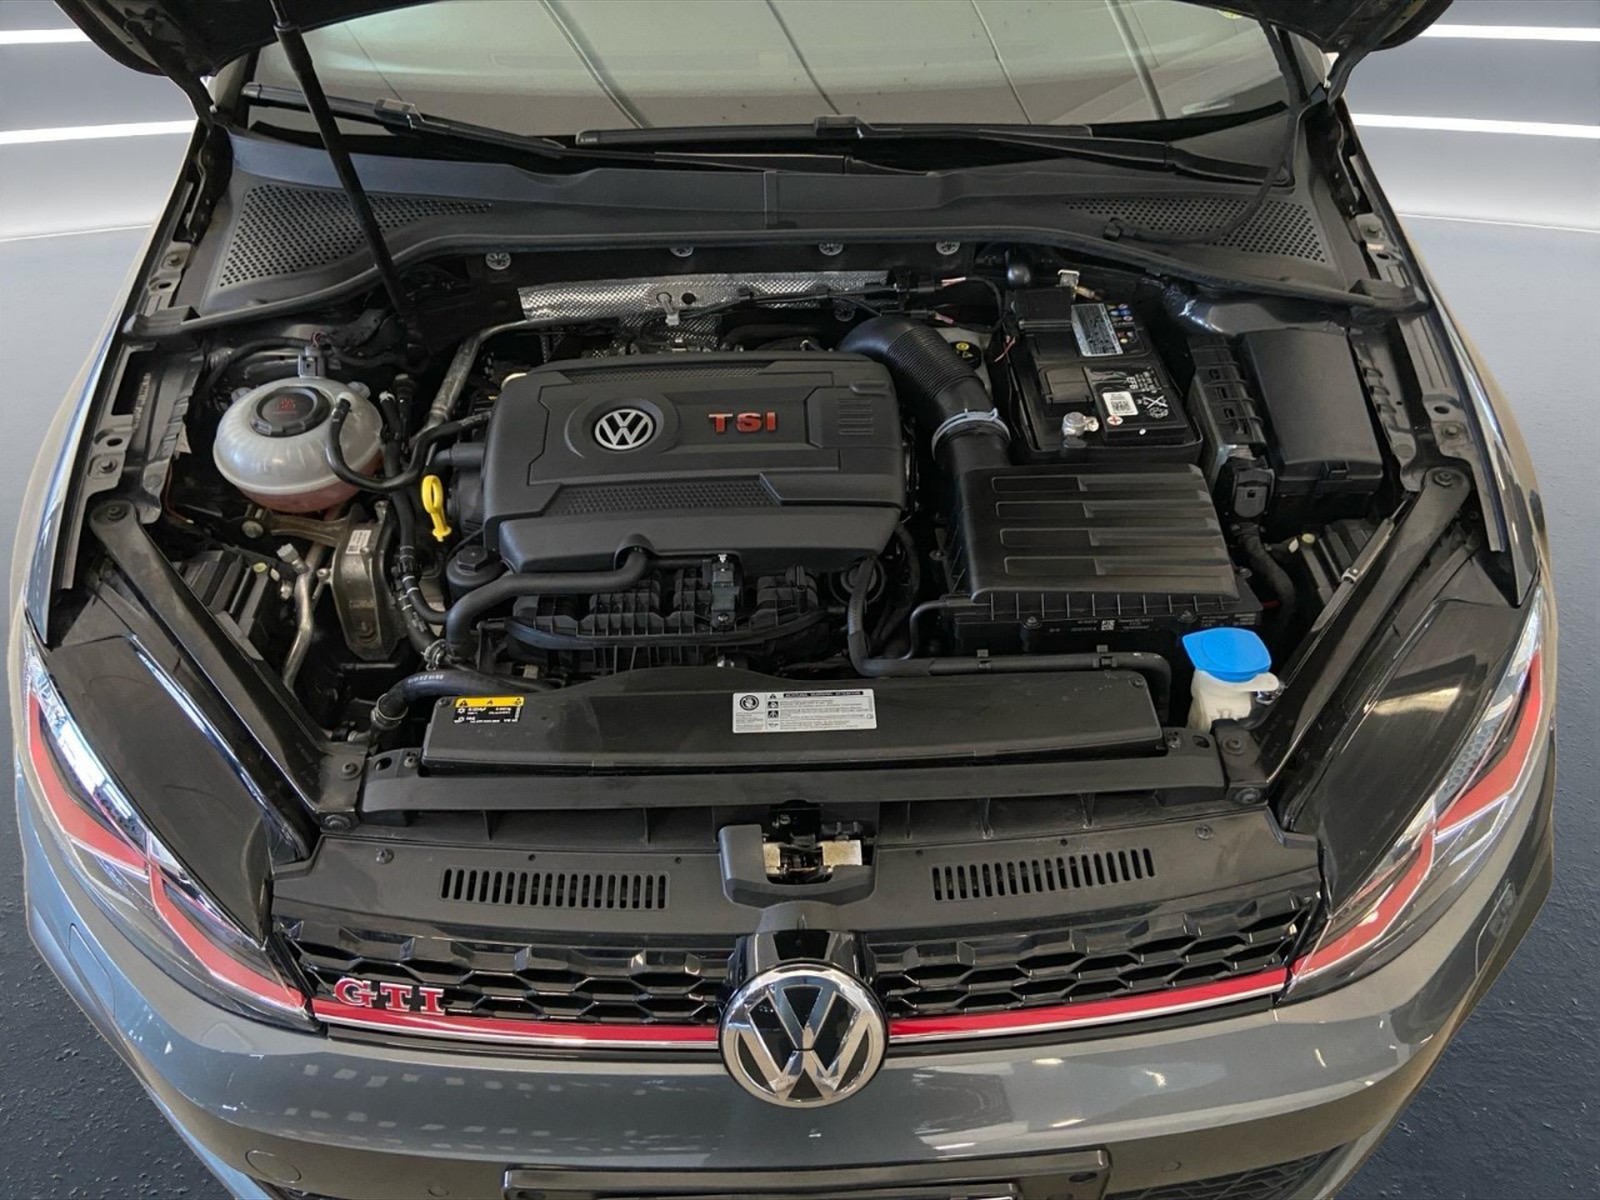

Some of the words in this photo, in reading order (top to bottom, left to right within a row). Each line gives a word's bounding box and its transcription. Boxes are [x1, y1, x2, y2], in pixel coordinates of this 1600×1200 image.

[595, 408, 653, 450] VW
[708, 412, 777, 433] TSI
[333, 977, 445, 1016] GTI
[721, 963, 885, 1108] VW
